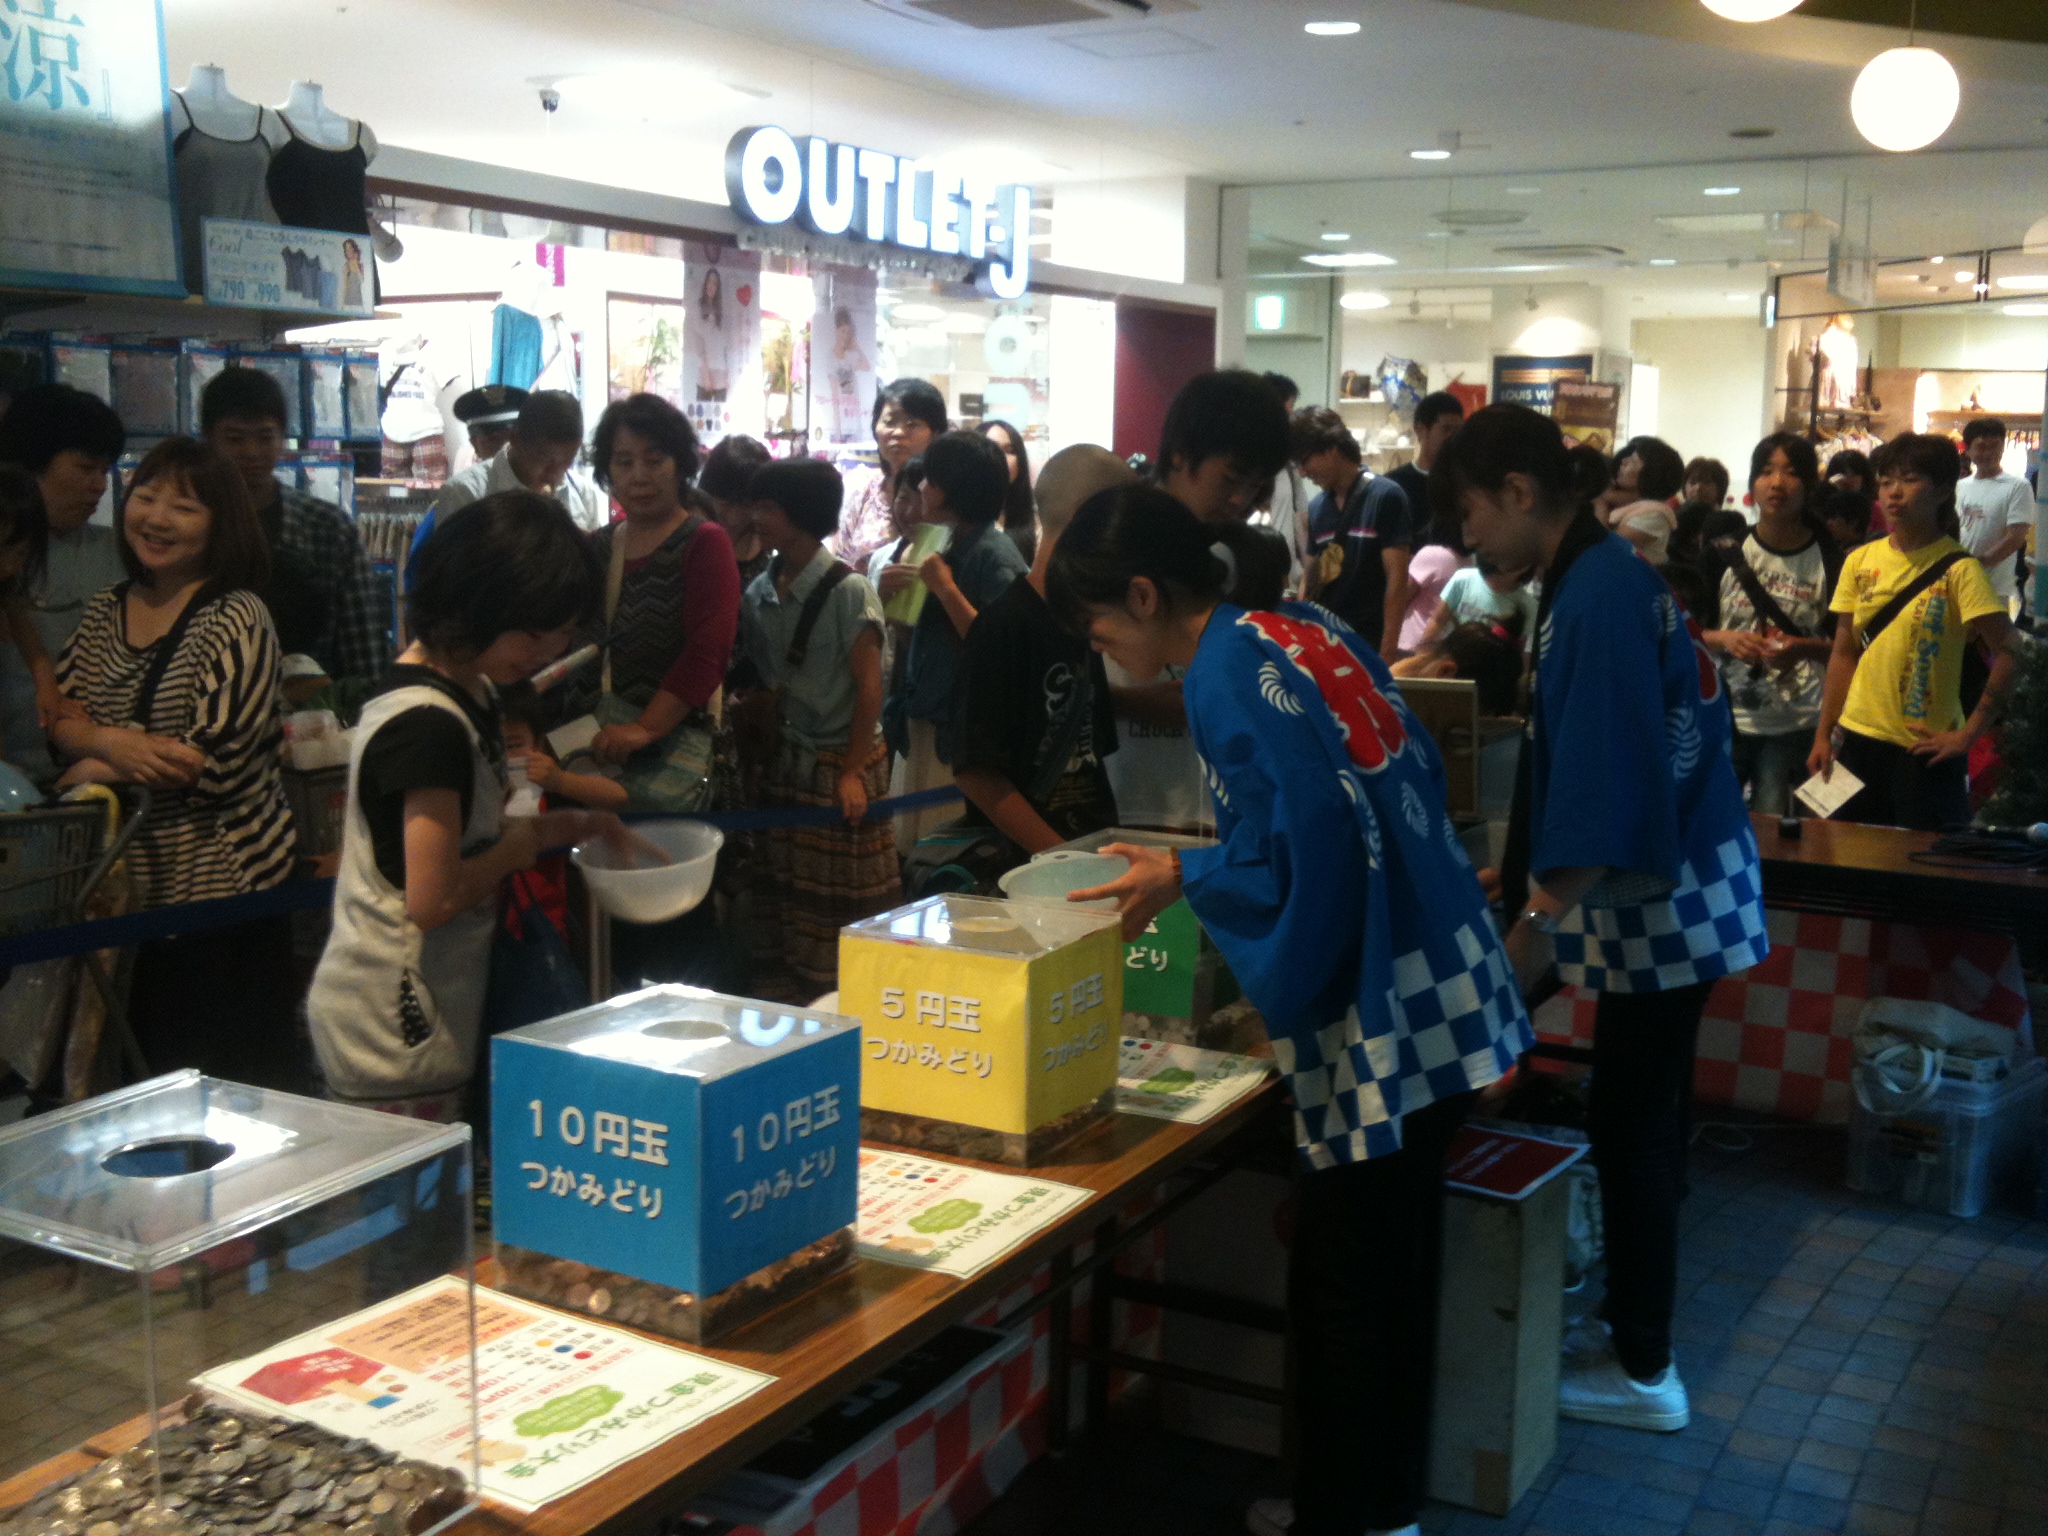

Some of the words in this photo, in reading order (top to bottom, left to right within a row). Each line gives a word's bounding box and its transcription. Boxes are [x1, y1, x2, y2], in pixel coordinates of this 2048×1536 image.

[730, 125, 1032, 299] OUTLET-J
[881, 986, 982, 1032] 5円玉
[1049, 973, 1103, 1024] 5円玉
[867, 1037, 993, 1078] つかみどり
[1042, 1020, 1108, 1072] つかみどり
[529, 1099, 670, 1166] 10円玉
[731, 1084, 841, 1162] 10円玉
[520, 1161, 664, 1219] つかみどり
[725, 1145, 837, 1219] つかみどり
[501, 1370, 724, 1481] 現金つかみどり大会
